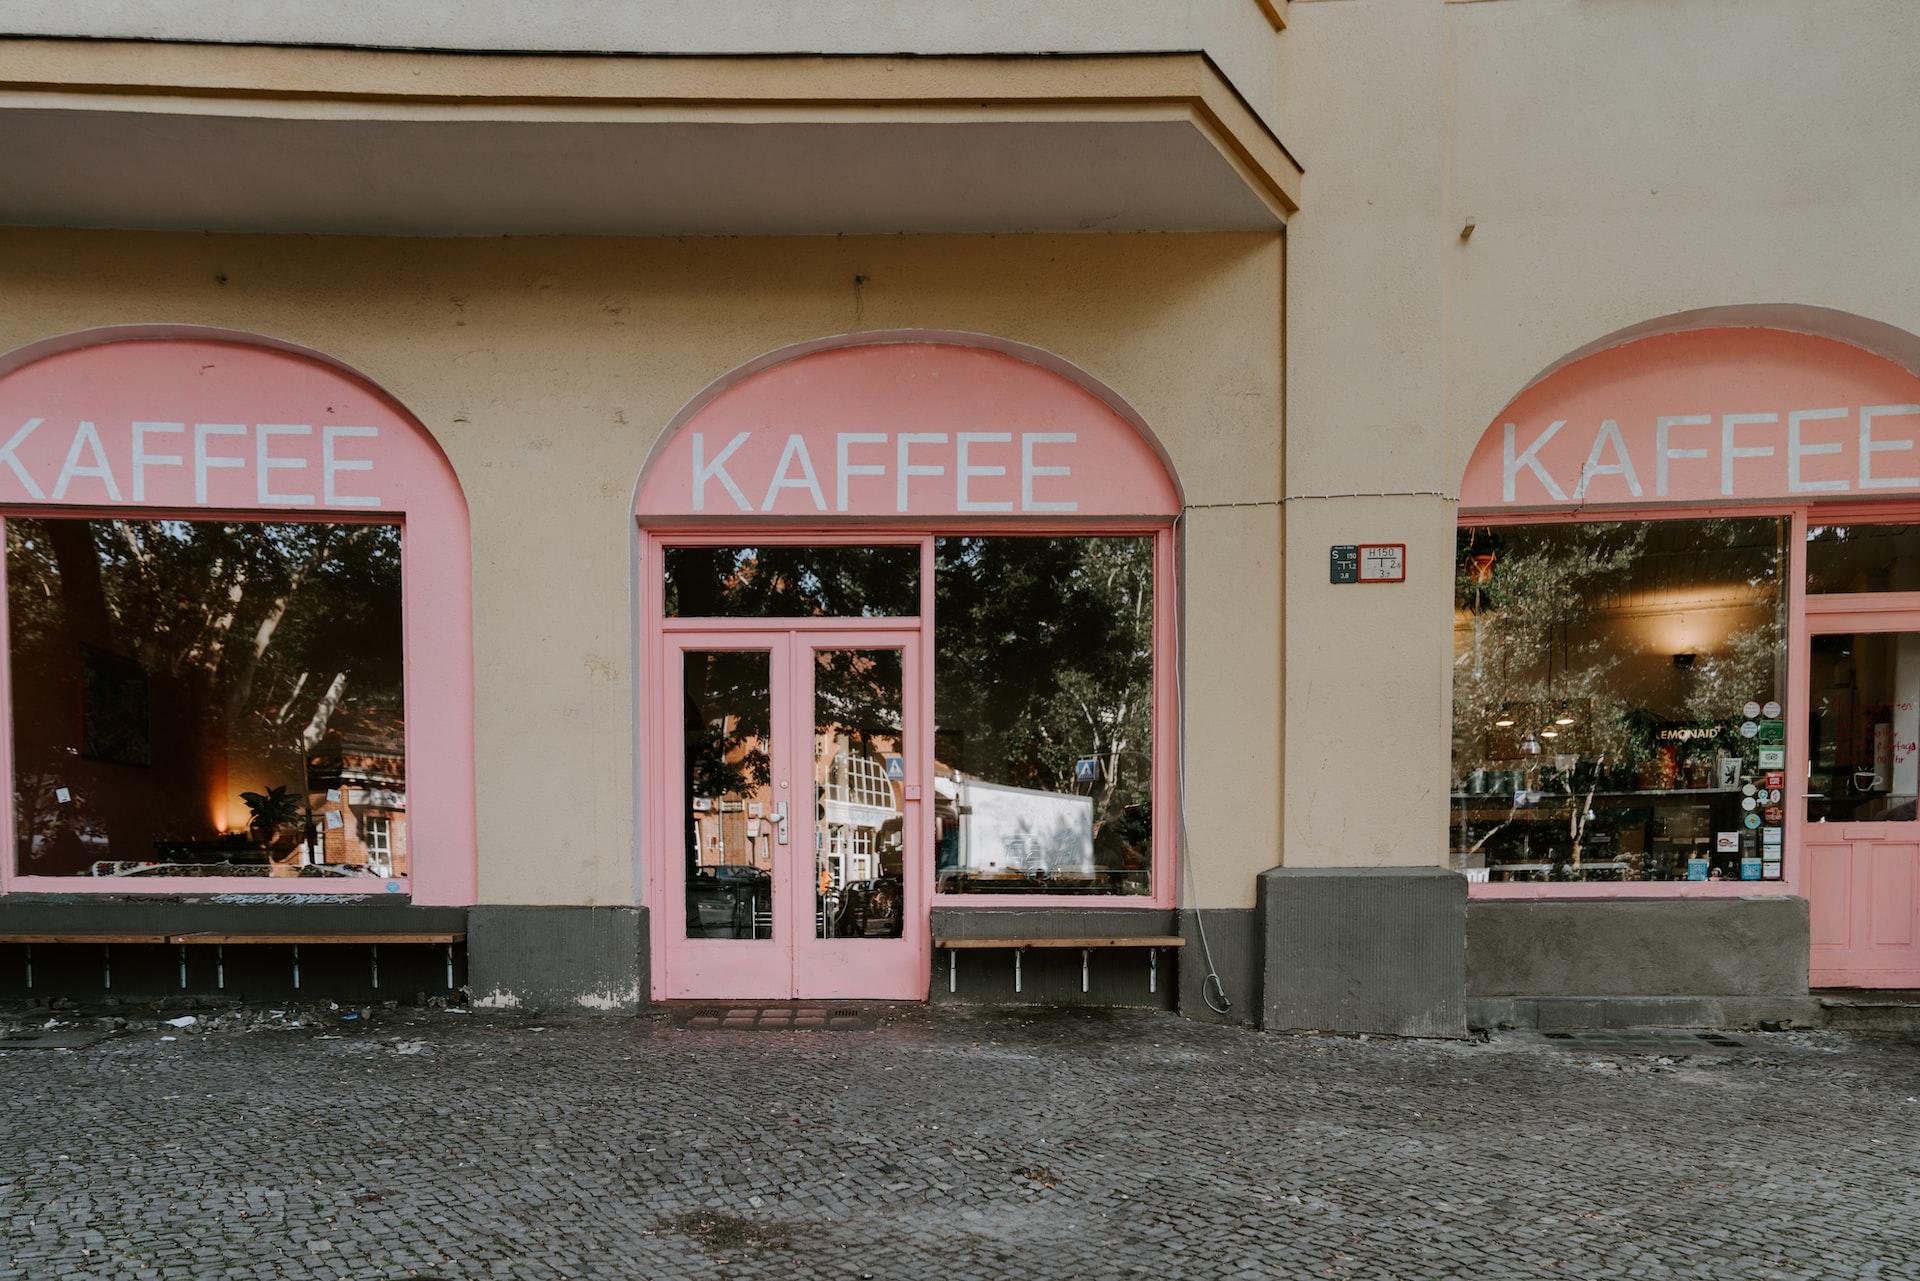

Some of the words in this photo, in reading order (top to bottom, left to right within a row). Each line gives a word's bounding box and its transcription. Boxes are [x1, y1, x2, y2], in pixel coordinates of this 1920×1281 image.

[0, 417, 382, 507] KAFFEE
[691, 431, 1079, 513] KAFFEE
[1503, 404, 1920, 502] KAFFEE
[1332, 550, 1339, 559] S
